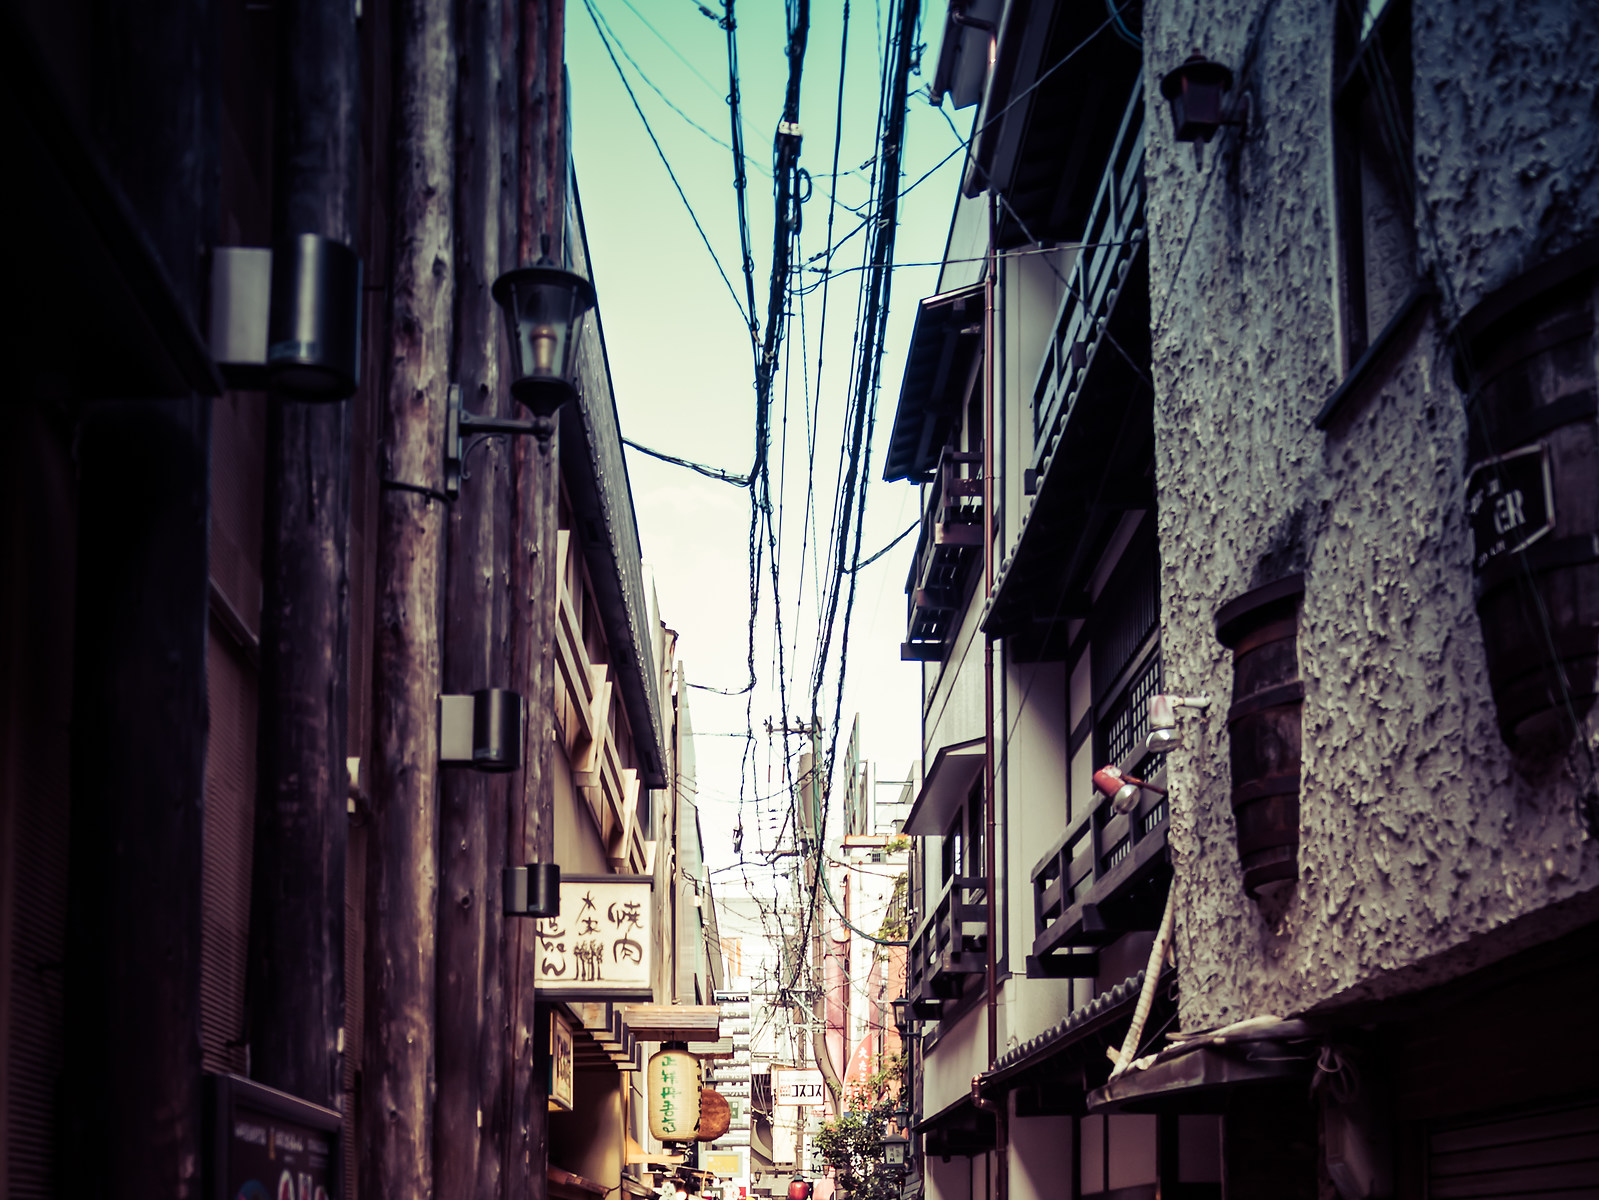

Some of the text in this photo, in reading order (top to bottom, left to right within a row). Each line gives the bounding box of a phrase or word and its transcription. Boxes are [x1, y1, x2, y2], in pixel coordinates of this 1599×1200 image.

[607, 900, 644, 966] 焼肉
[791, 1084, 822, 1098] コスコス
